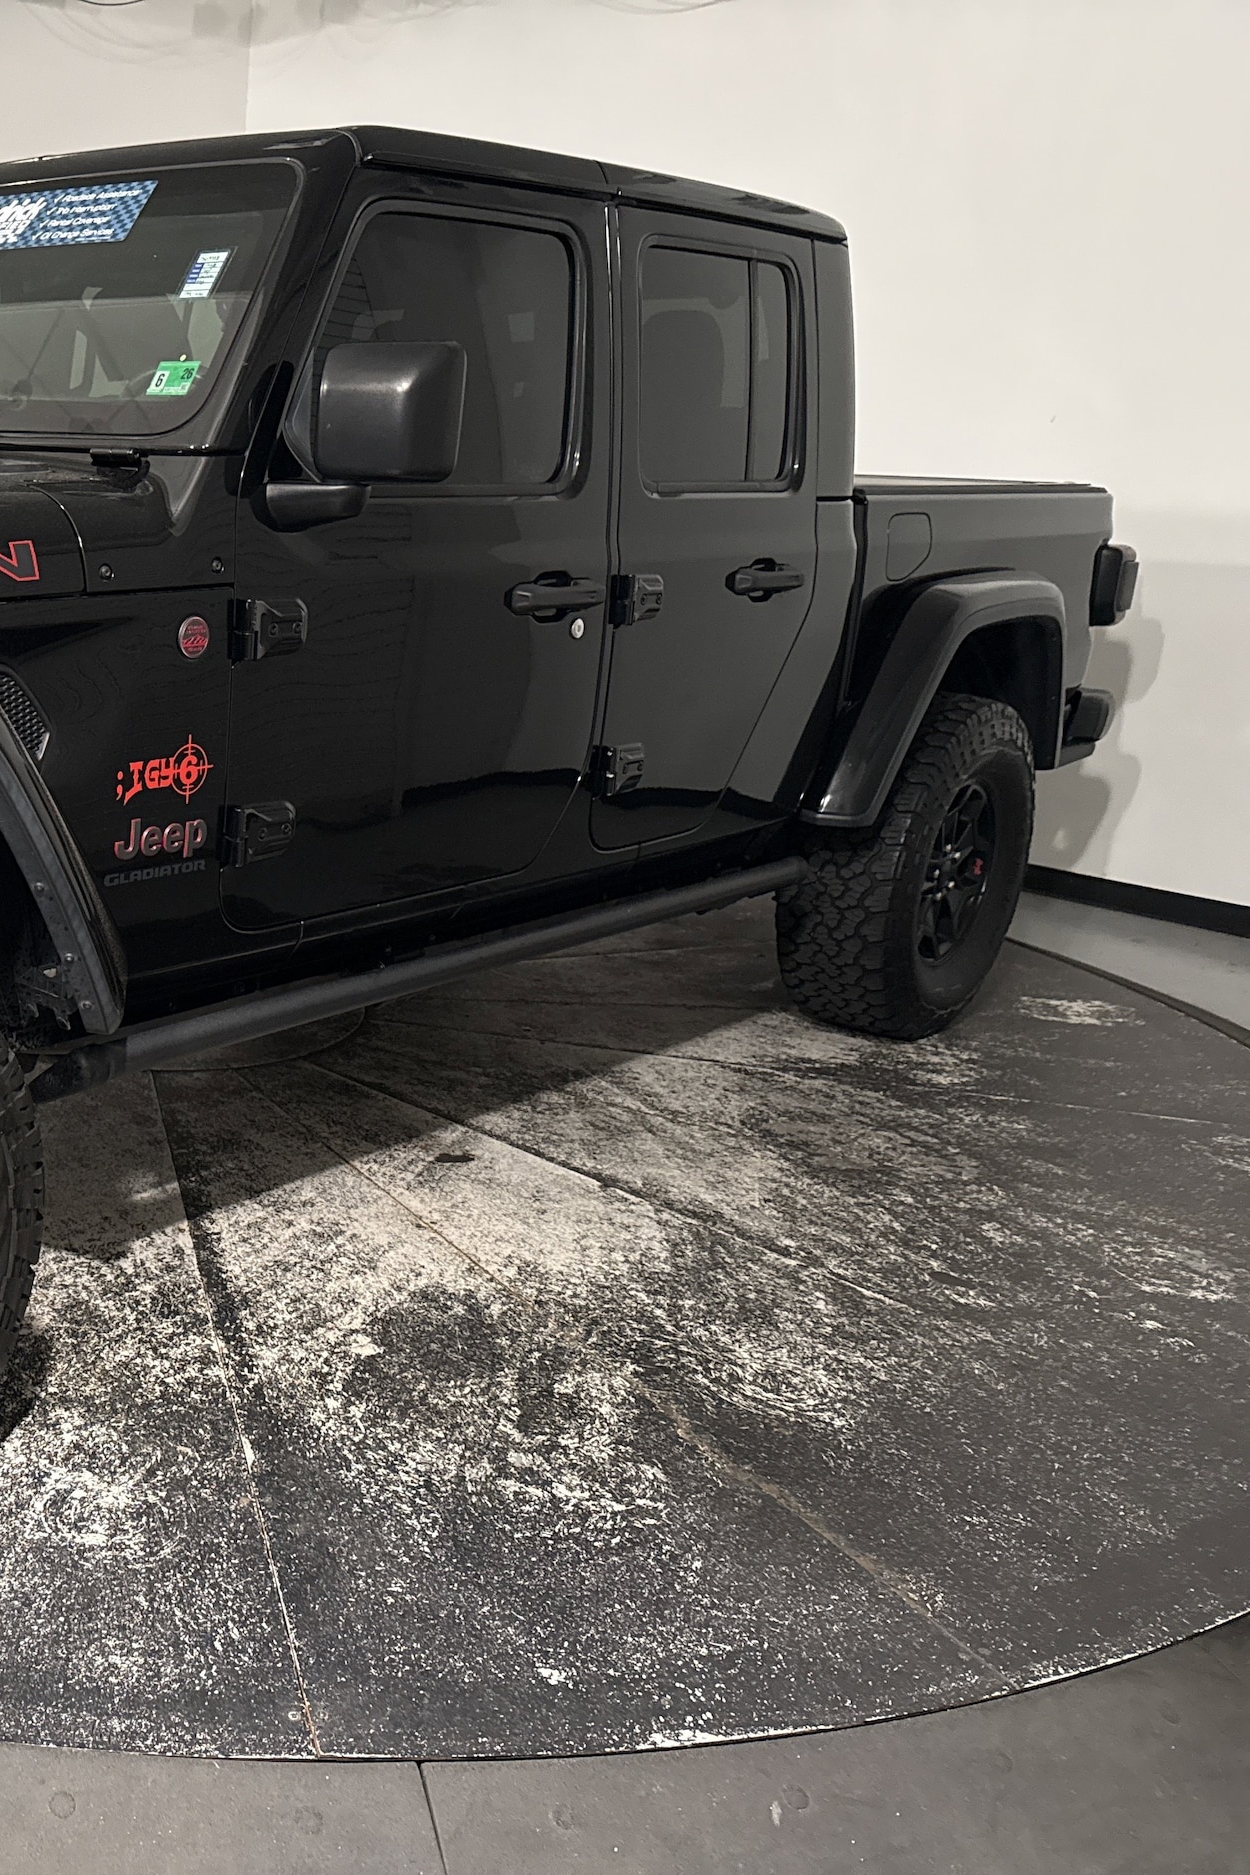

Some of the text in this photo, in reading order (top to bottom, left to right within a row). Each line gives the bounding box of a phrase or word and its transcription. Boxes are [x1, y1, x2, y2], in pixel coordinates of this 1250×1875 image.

[155, 373, 166, 388] 6
[180, 367, 195, 380] 26
[114, 818, 208, 861] Jeep
[104, 859, 206, 886] GLADIATOR
